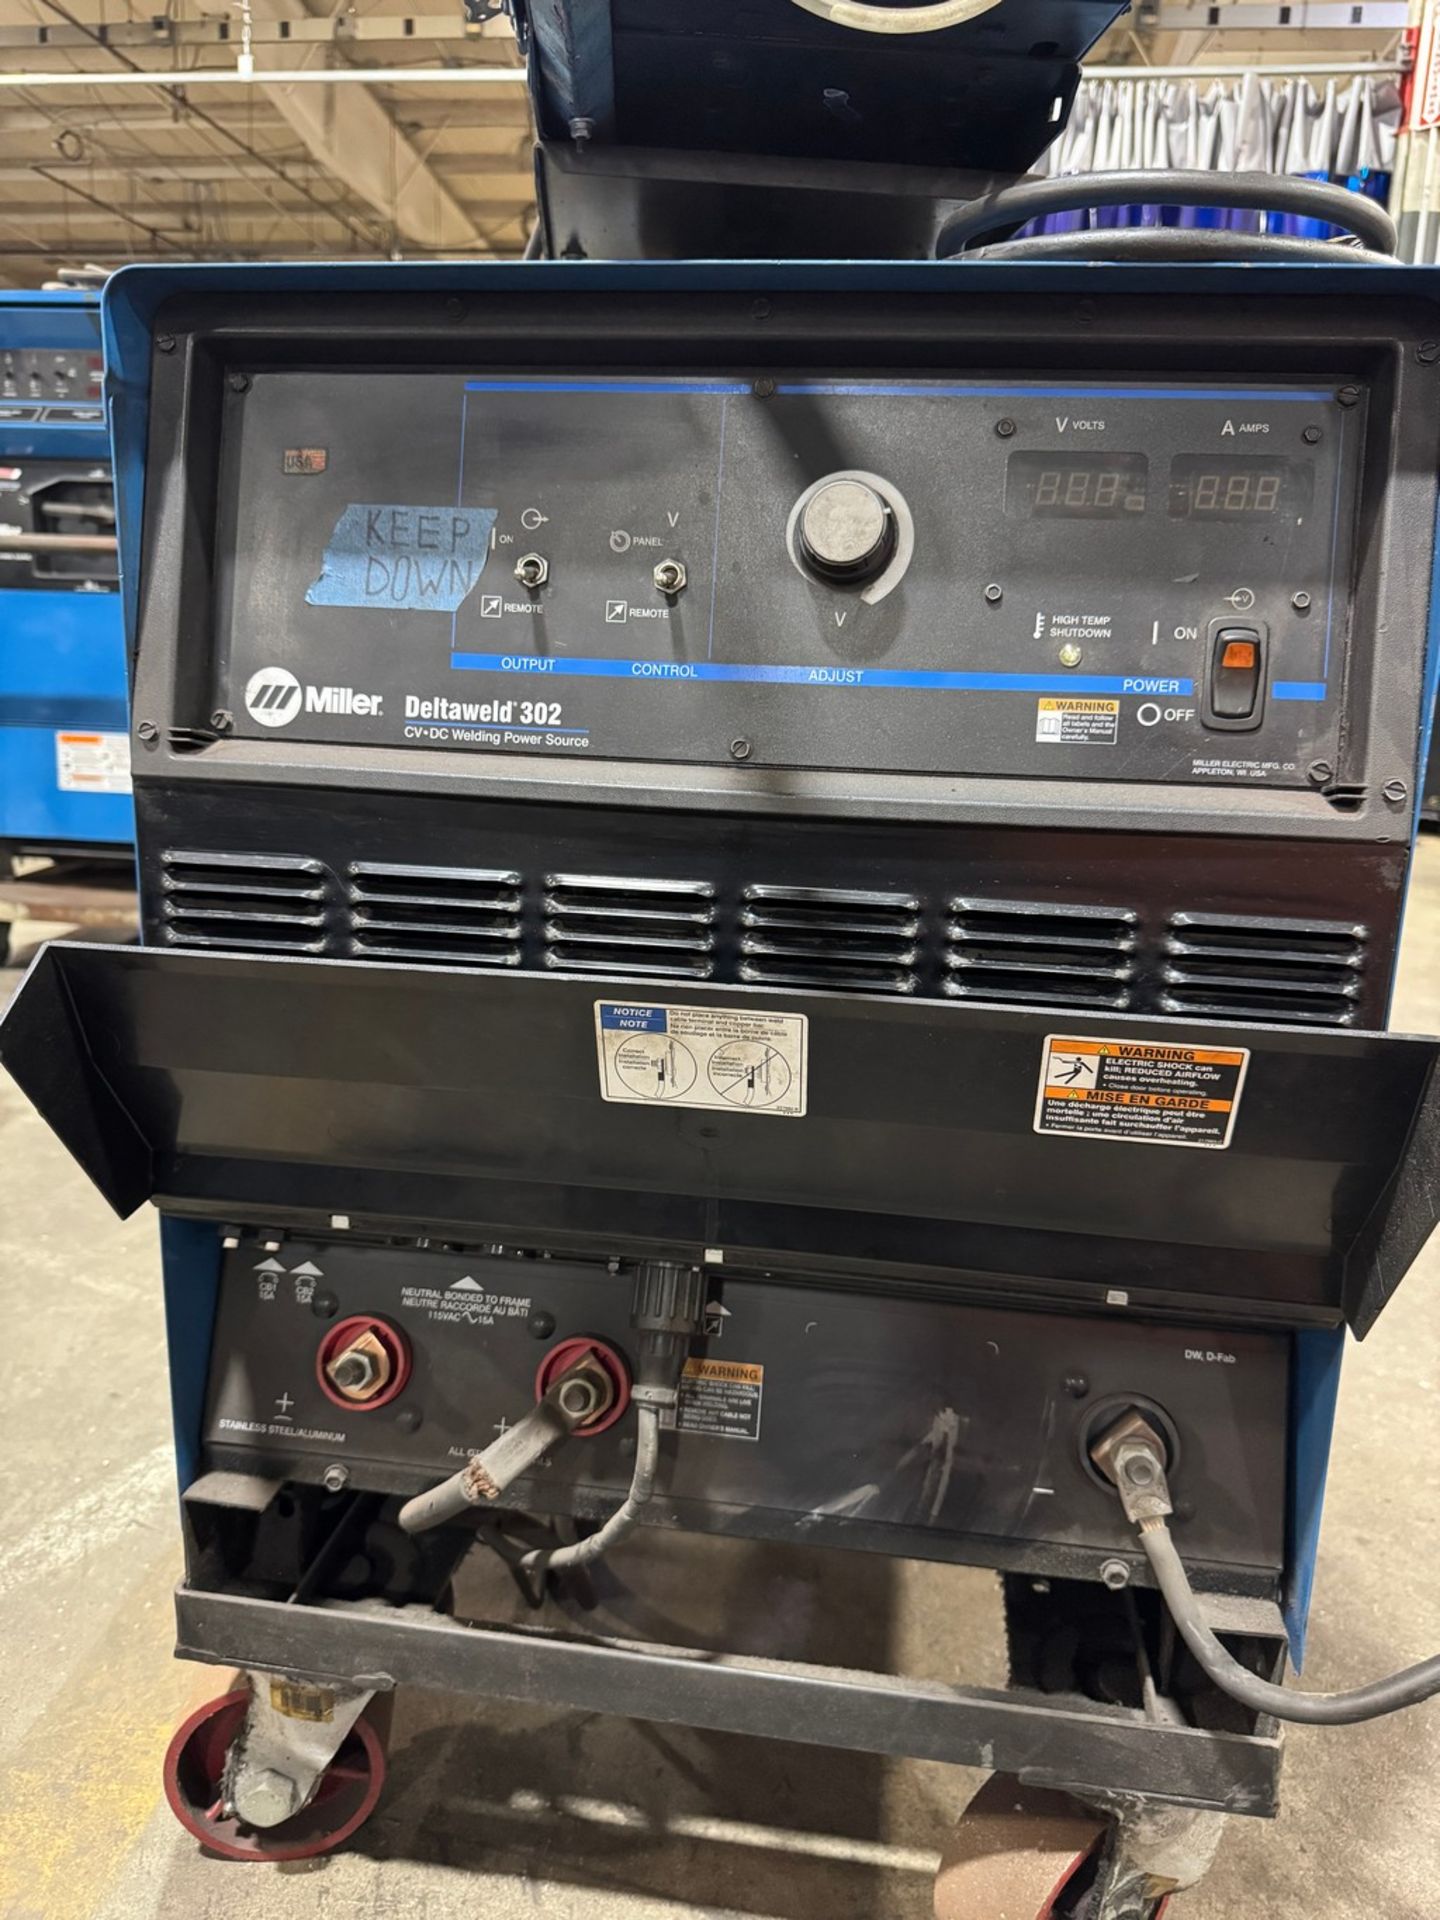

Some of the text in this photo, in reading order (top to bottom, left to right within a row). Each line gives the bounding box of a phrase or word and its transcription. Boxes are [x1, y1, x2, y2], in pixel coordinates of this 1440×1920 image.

[1055, 417, 1105, 432] V VOLTS
[1221, 420, 1270, 436] A AMPS
[286, 455, 312, 469] USA
[667, 511, 680, 528] V
[366, 509, 470, 553] KEEP
[499, 535, 514, 544] ON
[632, 537, 664, 547] PANEL
[365, 555, 473, 601] DOWN
[504, 602, 544, 614] REMOTE
[629, 608, 669, 619] REMOTE
[835, 611, 847, 627] V
[1052, 615, 1111, 626] HIGH TEMP
[1050, 627, 1112, 639] SHUTDOWN
[1174, 626, 1197, 640] ON
[501, 657, 556, 671] OUTPUT
[631, 663, 698, 678] CONTROL
[808, 670, 864, 683] ADJUST
[1123, 679, 1179, 692] POWER
[305, 686, 380, 716] Miller
[1056, 701, 1115, 712] WARNING
[404, 695, 562, 725] Deltaweld 302
[1164, 708, 1195, 722] OFF
[452, 730, 500, 745] Welding
[504, 732, 542, 745] Power
[545, 734, 589, 748] Source
[1192, 759, 1220, 767] MILLER
[1222, 760, 1260, 769] ELECTRIC
[613, 1007, 653, 1018] NOTICE
[619, 1020, 648, 1029] NOTE
[1118, 1046, 1195, 1061] WARNING
[1105, 1058, 1154, 1068] ELECTRIC
[1156, 1061, 1193, 1071] SHOCK
[1124, 1067, 1172, 1077] REDUCED
[1174, 1070, 1221, 1081] AIRFLOW
[1130, 1083, 1147, 1091] door
[1148, 1085, 1171, 1093] before
[1138, 1076, 1199, 1087] overheating.
[1086, 1091, 1210, 1109] MISE EN GARDE
[1047, 1107, 1085, 1116] mortelle
[1111, 1112, 1161, 1122] circulation
[1162, 1115, 1184, 1123] d'air
[1068, 1101, 1111, 1111] décharge
[1113, 1104, 1161, 1115] électrique
[1162, 1109, 1184, 1117] peut
[1185, 1110, 1206, 1118] être
[1101, 1118, 1117, 1126] fait
[1119, 1120, 1173, 1130] surchauffer
[1174, 1125, 1221, 1135] l'appareil.
[259, 1282, 277, 1291] CB1
[296, 1286, 314, 1296] CB2
[259, 1290, 275, 1300] 15A
[296, 1294, 313, 1304] 15A
[401, 1287, 532, 1308] NEUTRAL BONDED TO FRAME
[401, 1297, 439, 1309] NEUTRE
[492, 1305, 506, 1315] AU
[428, 1310, 460, 1322] 115VAC
[1206, 1351, 1236, 1364] D-Fab
[700, 1364, 758, 1379] WARNING
[219, 1418, 346, 1442] STAINLESS STEEL/ALUMINUM
[448, 1446, 465, 1457] ALL
